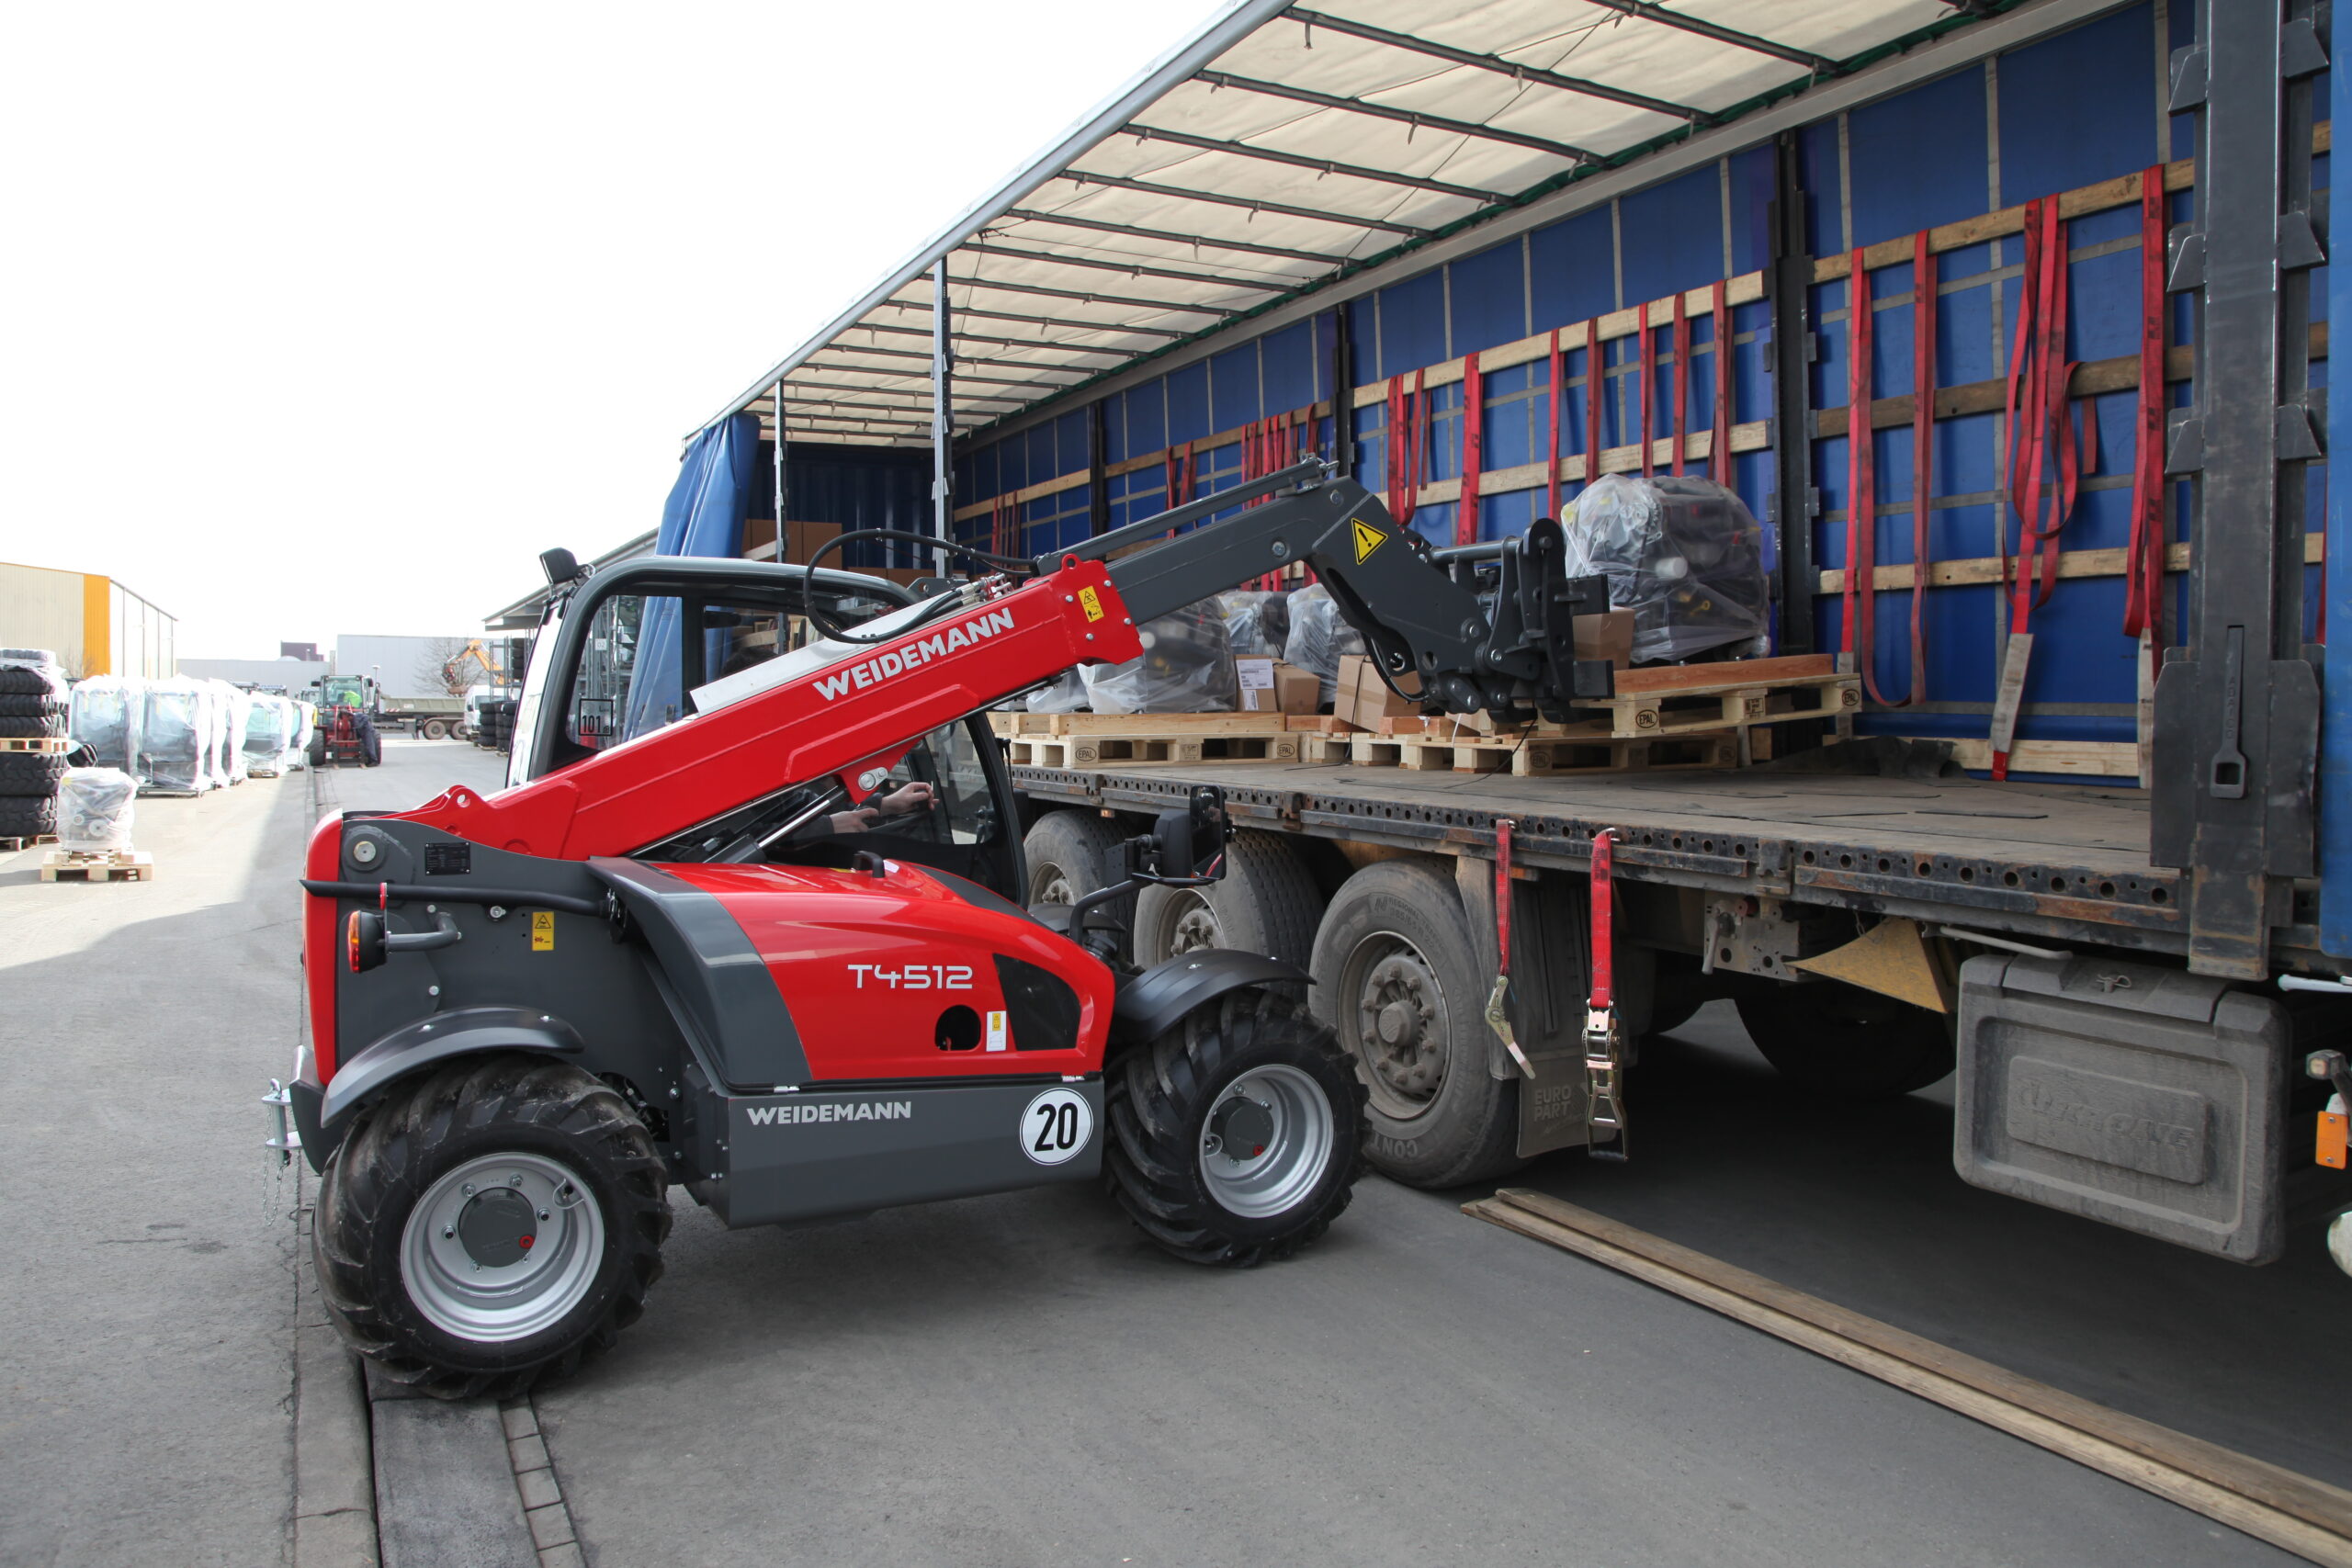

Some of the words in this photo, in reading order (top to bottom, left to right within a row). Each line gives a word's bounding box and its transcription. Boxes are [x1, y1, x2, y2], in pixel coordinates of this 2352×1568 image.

[812, 607, 1014, 700] WEIDEMANN
[582, 715, 601, 733] 101
[1639, 713, 1656, 725] EPAL
[1078, 750, 1094, 759] EPAL
[1279, 746, 1293, 755] EPAL
[848, 964, 973, 989] T4512
[1535, 1085, 1572, 1105] EURO
[746, 1100, 911, 1125] WEIDEMANN
[1533, 1101, 1571, 1122] PART
[1035, 1102, 1079, 1152] 20
